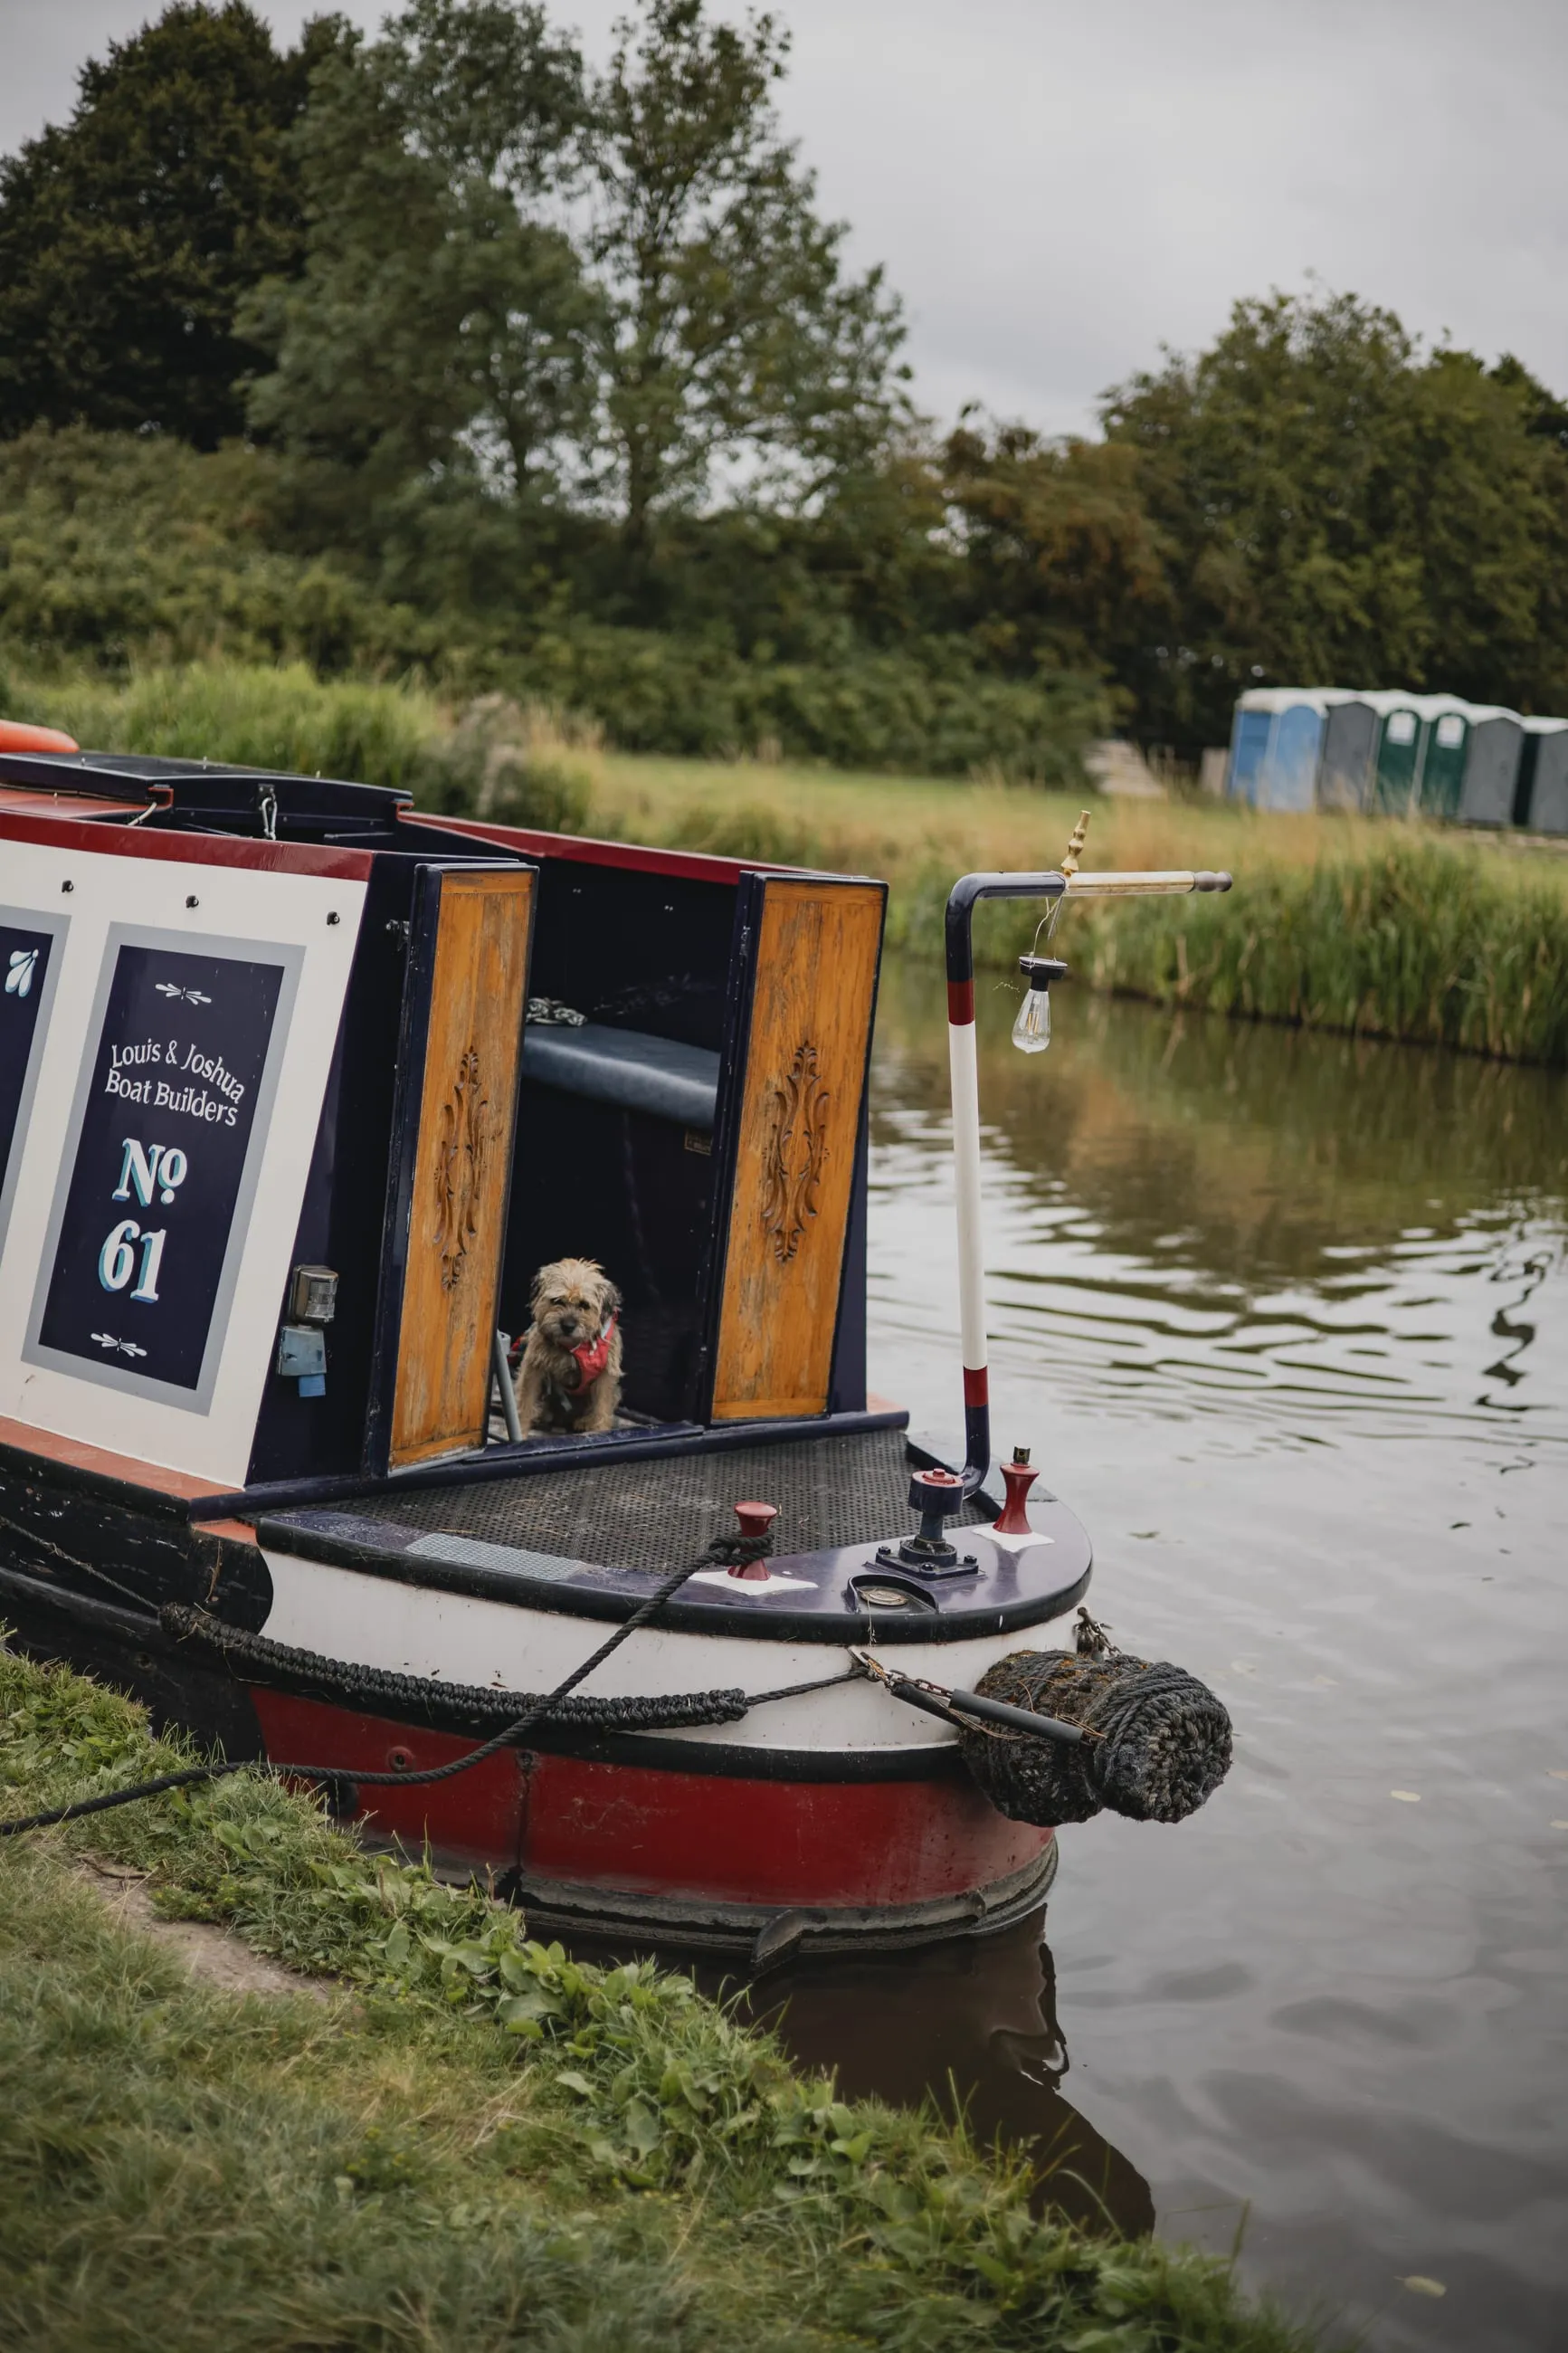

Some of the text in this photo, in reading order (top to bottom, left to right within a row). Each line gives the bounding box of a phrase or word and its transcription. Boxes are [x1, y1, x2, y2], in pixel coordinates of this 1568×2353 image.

[105, 1068, 239, 1127] Boat Builders
[111, 1038, 245, 1104] Louis & Joshua
[99, 1220, 166, 1303] 61
